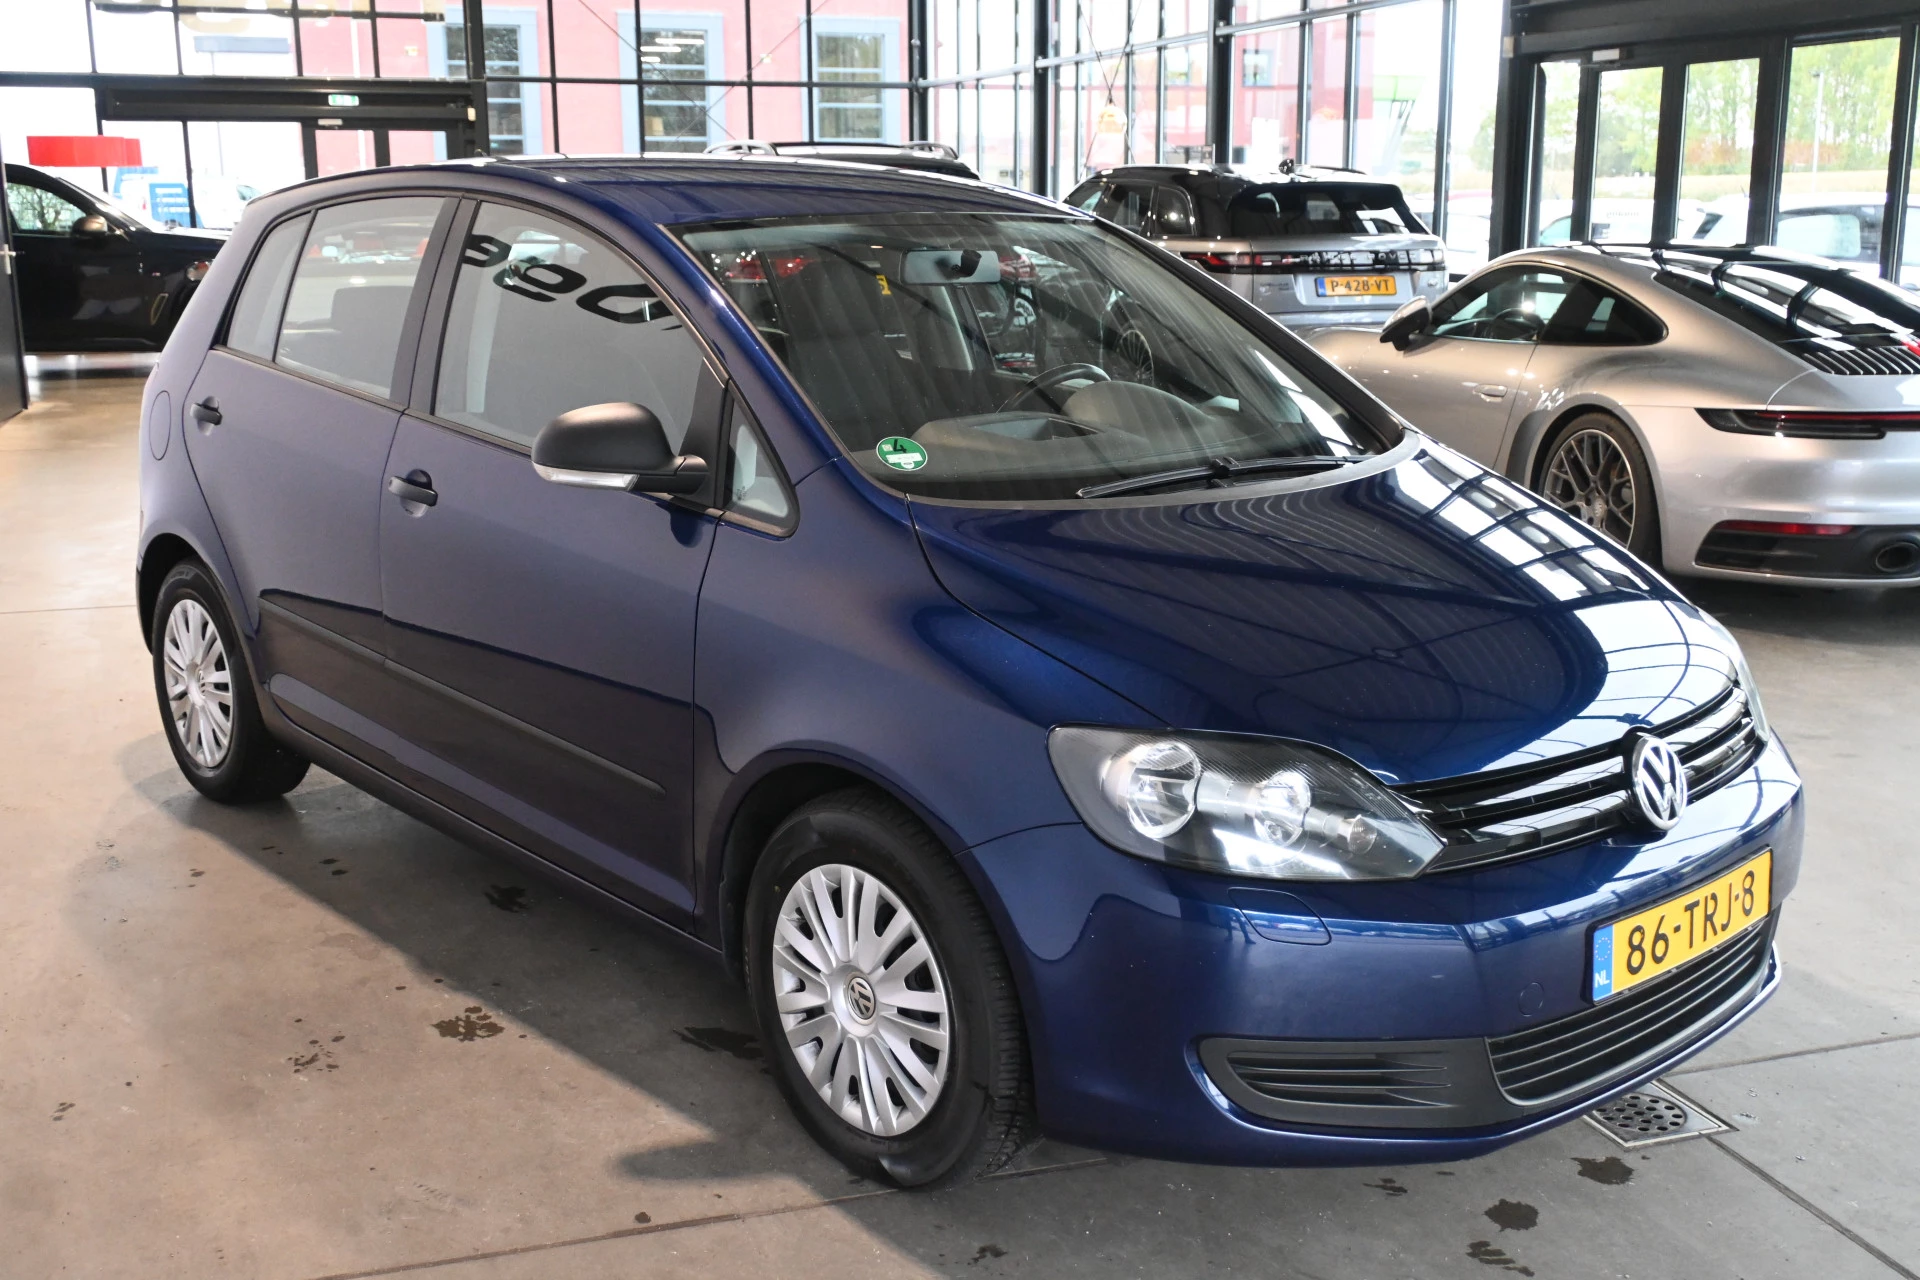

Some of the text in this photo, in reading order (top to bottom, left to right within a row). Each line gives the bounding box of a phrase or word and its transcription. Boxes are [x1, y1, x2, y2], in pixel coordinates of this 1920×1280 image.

[1330, 279, 1390, 292] P-428-VT
[1626, 869, 1755, 975] 86-TRJ-8
[1594, 968, 1610, 989] NL
